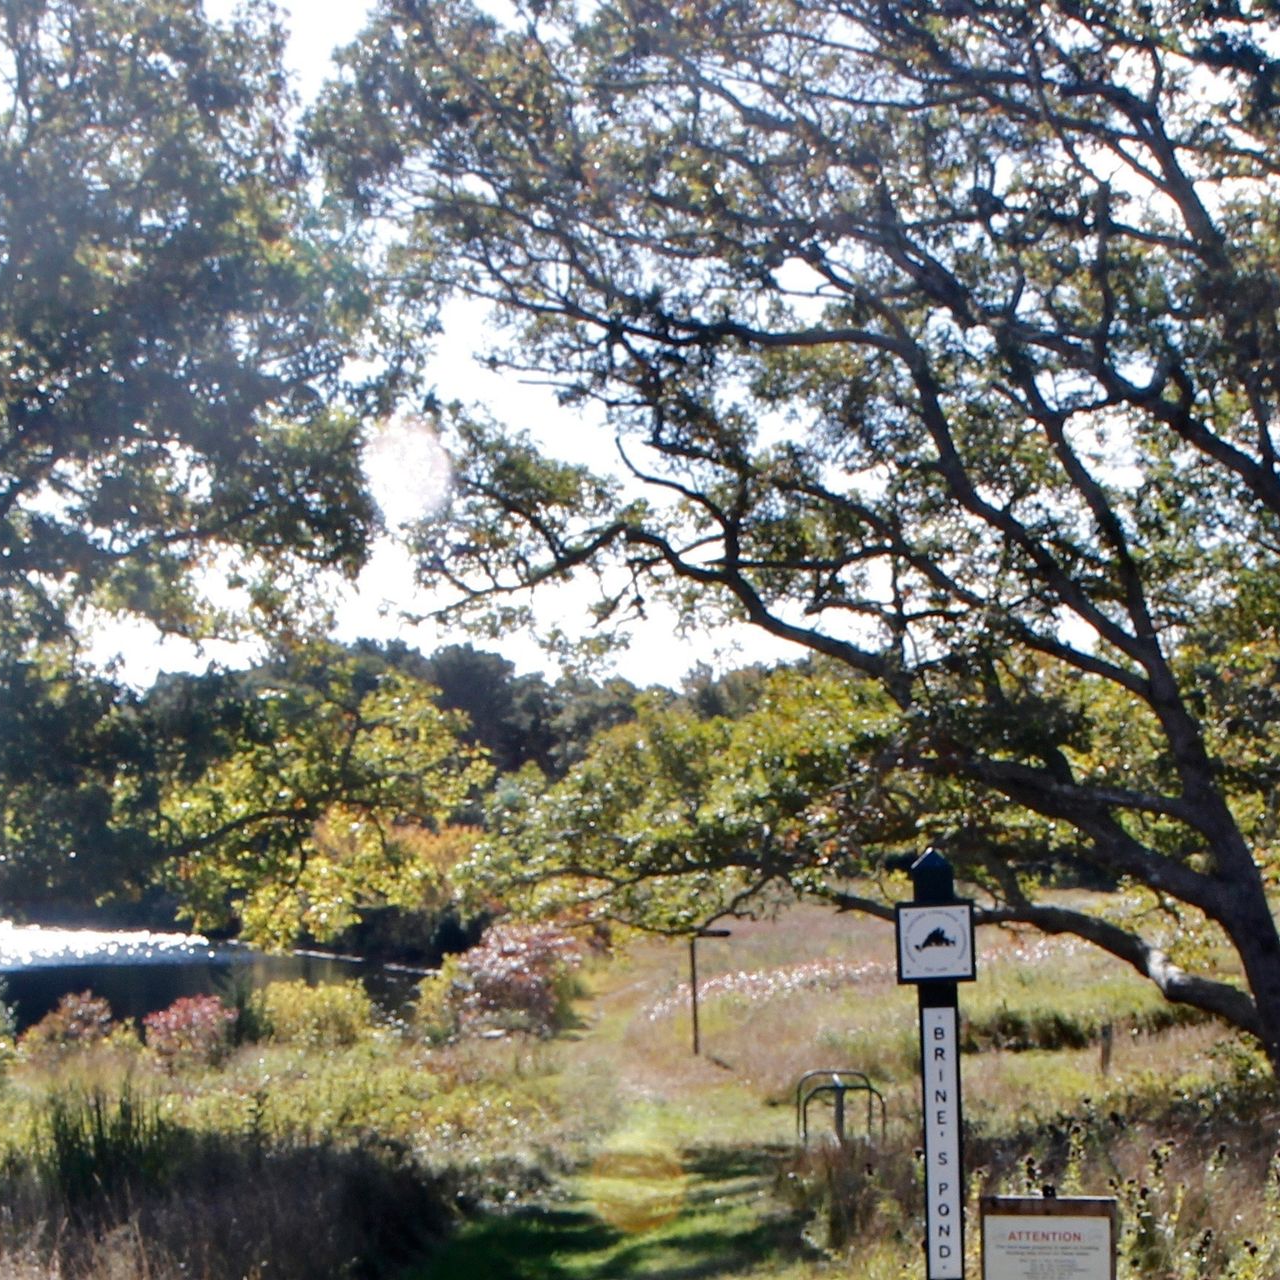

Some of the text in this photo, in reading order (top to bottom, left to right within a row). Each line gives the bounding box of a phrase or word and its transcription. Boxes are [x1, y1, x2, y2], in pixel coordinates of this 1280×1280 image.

[933, 1026, 952, 1259] BRINE'S POND
[1008, 1231, 1082, 1242] ATTENTION
